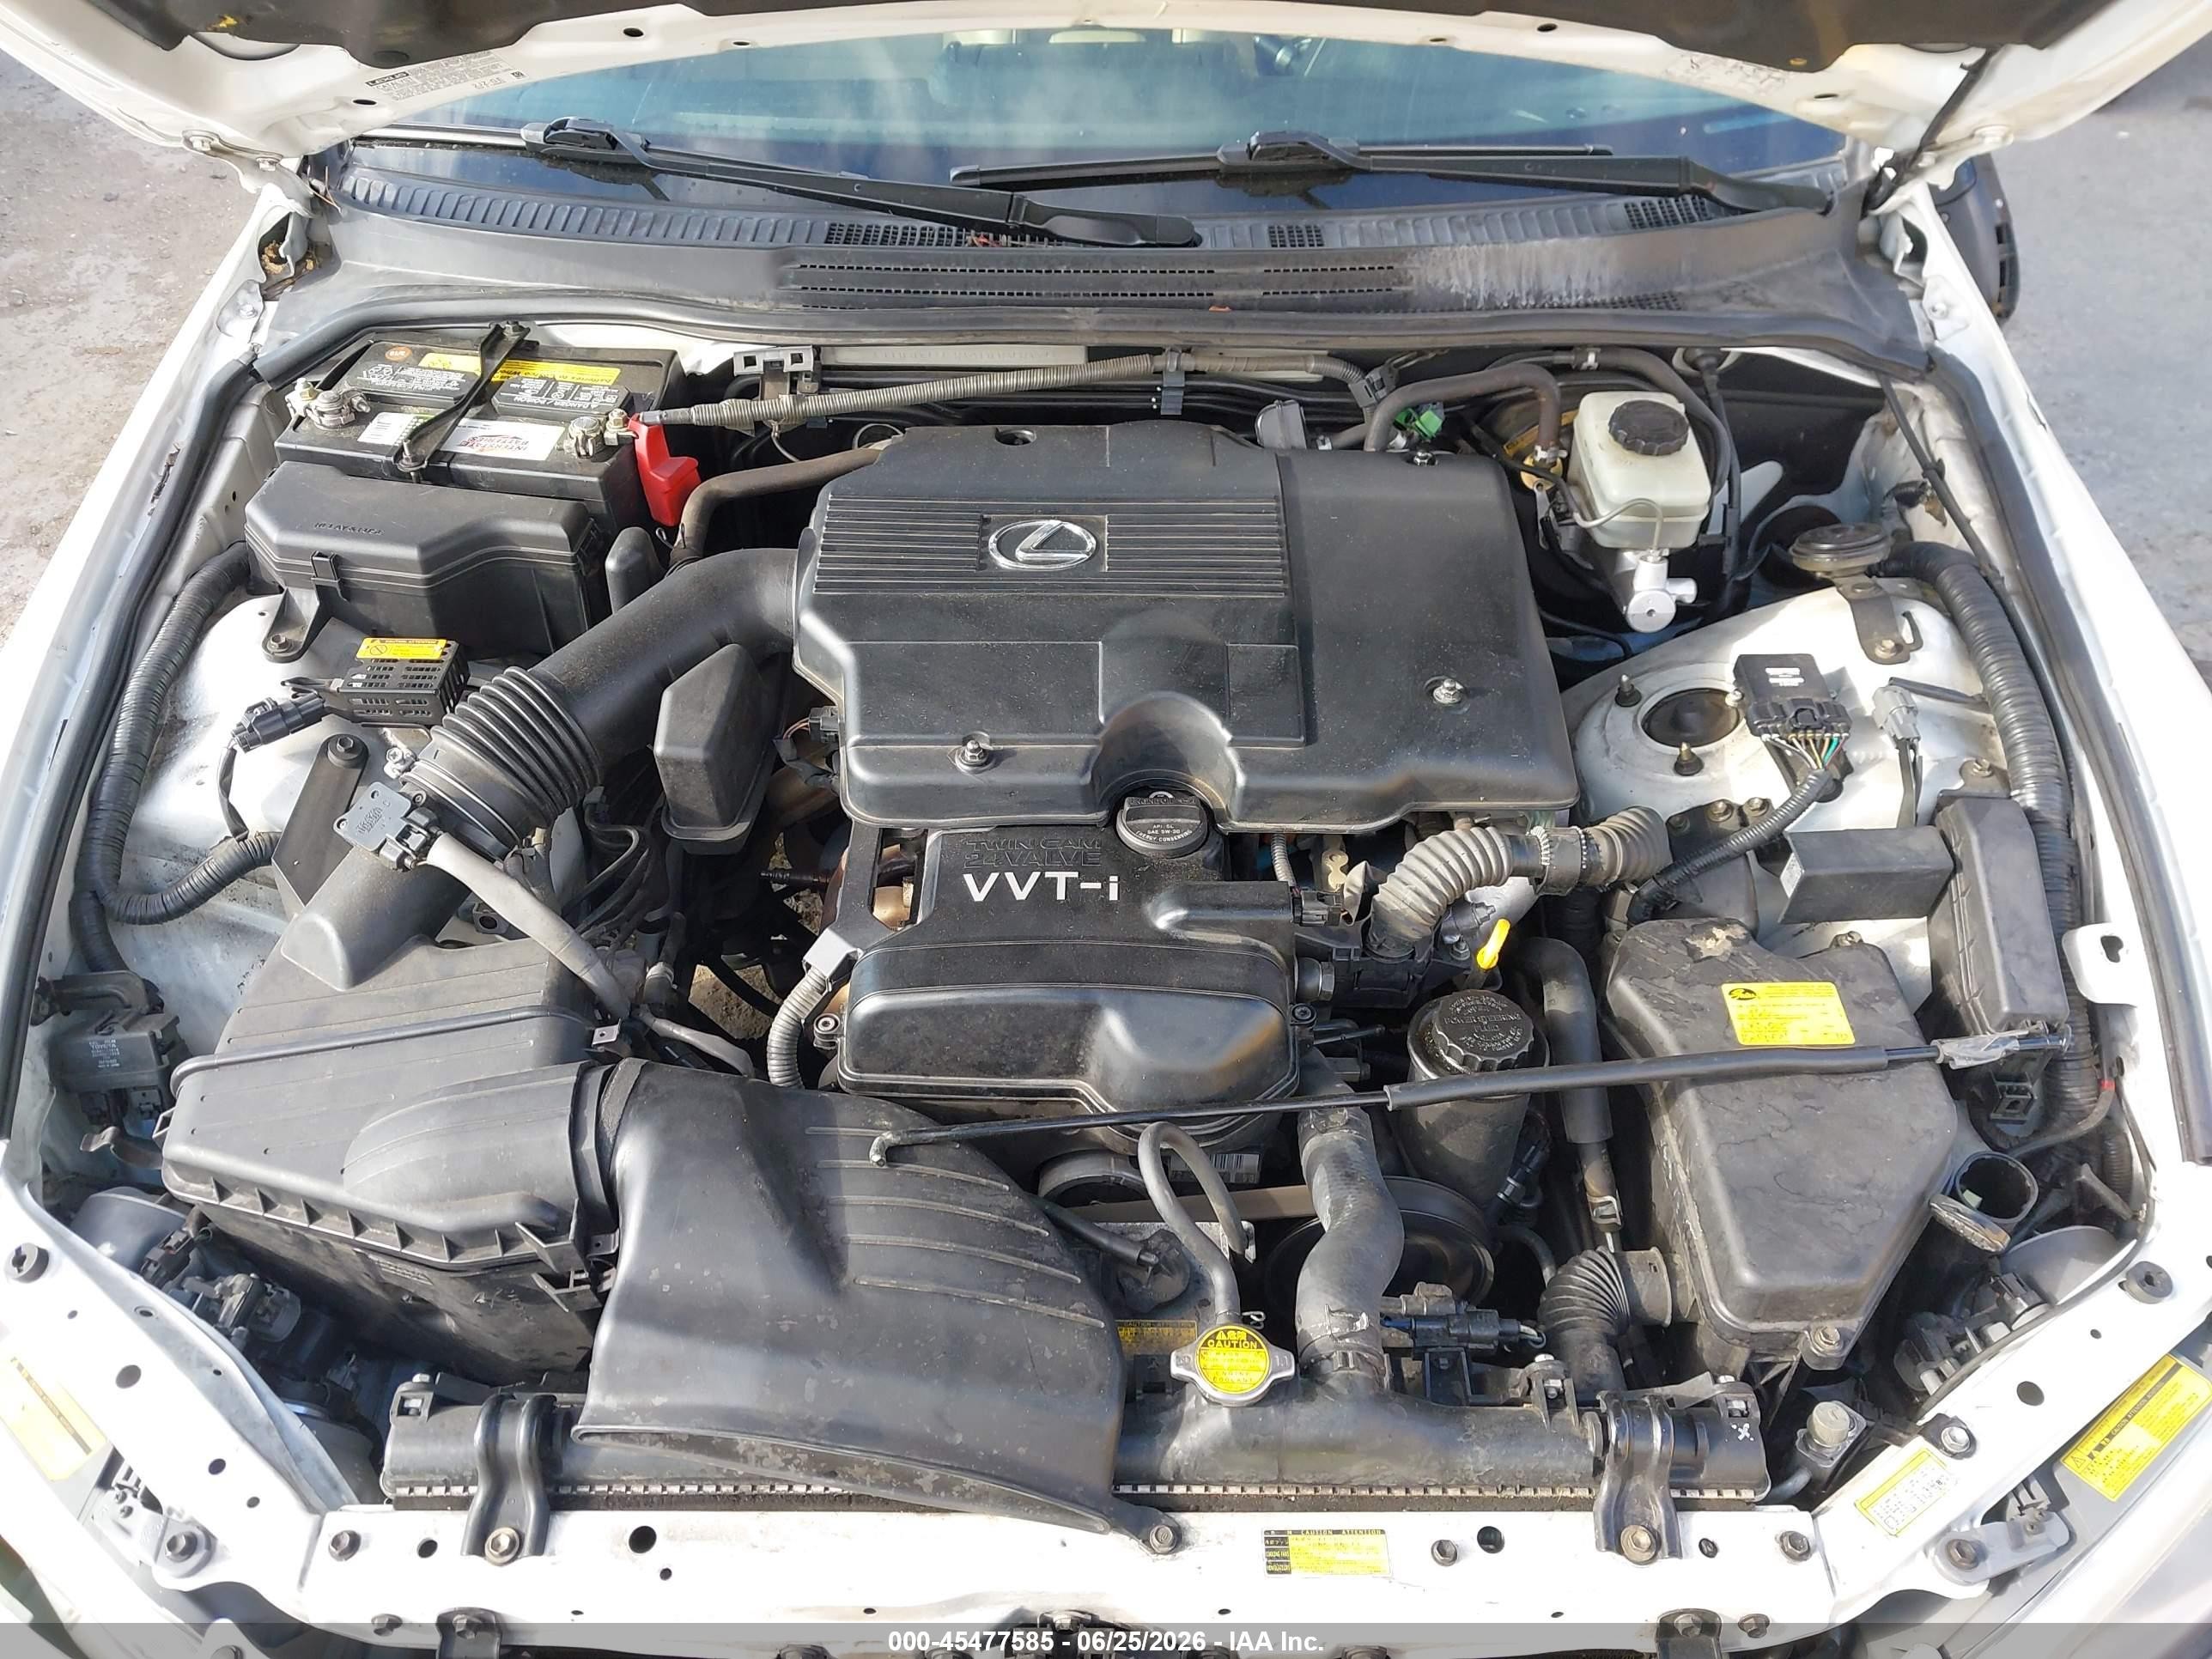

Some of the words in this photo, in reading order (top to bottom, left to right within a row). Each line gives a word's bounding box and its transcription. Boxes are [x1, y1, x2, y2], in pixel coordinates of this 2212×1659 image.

[514, 396, 547, 404] POISON
[1136, 830, 1157, 841] ENERGY
[1158, 830, 1193, 842] CONSERVING
[966, 838, 1035, 851] TWIN
[1040, 838, 1102, 849] CAM
[963, 872, 1119, 902] VVT-i
[1443, 1015, 1476, 1024] POWER
[1476, 1012, 1522, 1024] STEERING
[1207, 1340, 1258, 1349] CAUTION
